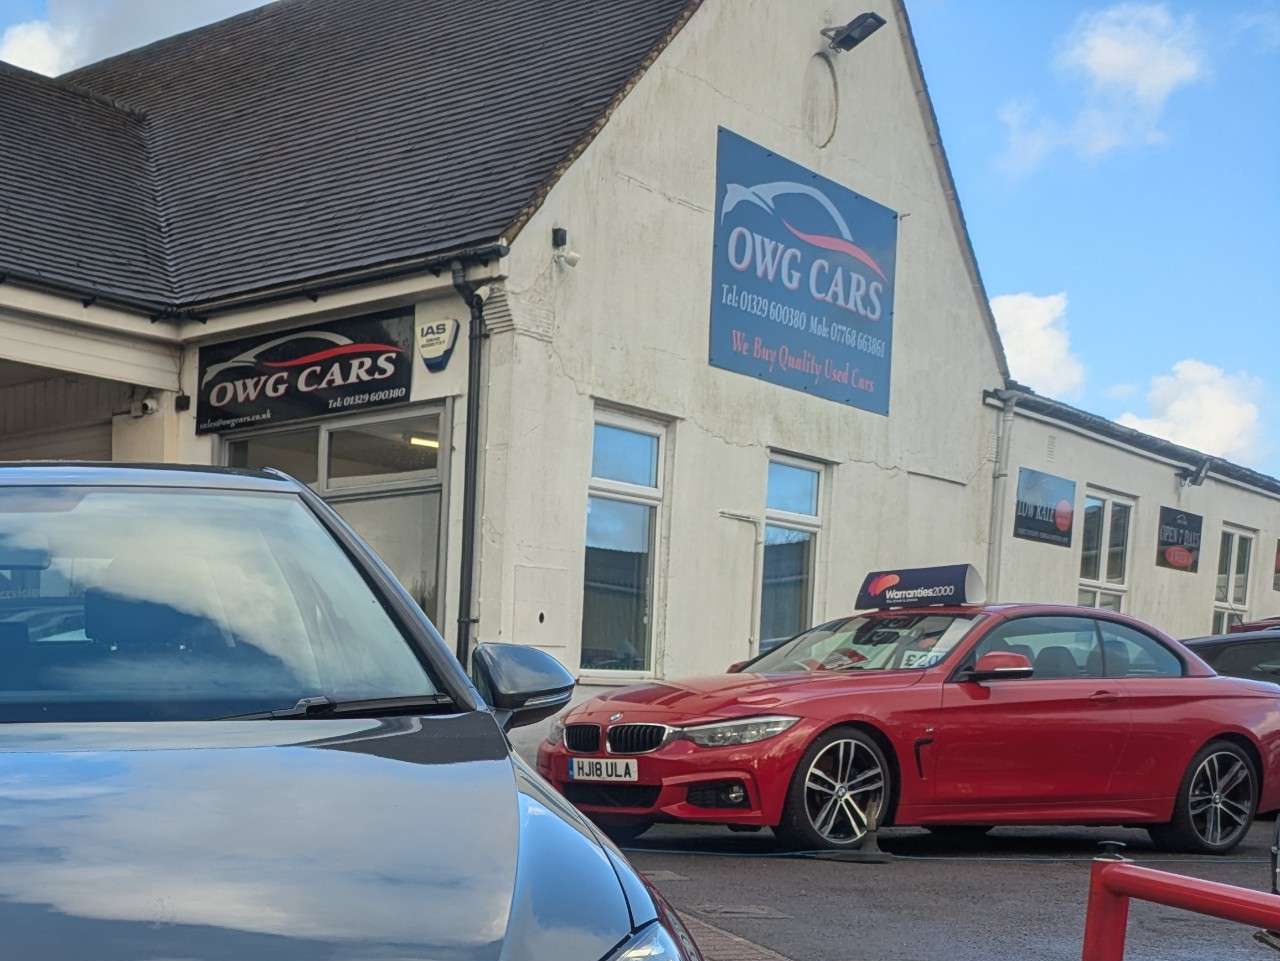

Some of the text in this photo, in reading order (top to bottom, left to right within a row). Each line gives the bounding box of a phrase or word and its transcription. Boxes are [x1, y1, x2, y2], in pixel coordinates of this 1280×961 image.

[727, 226, 883, 321] OWG CARS
[420, 323, 447, 338] IAS
[721, 283, 739, 307] Tel:
[739, 291, 768, 318] 01329
[769, 301, 807, 331] 600380
[830, 322, 857, 348] 07768
[209, 352, 397, 408] OWG CARS
[731, 329, 876, 393] We Buy Quality Used Cars
[327, 387, 406, 409] Tel: 01329 600380
[577, 761, 632, 778] HJ18 ULA
